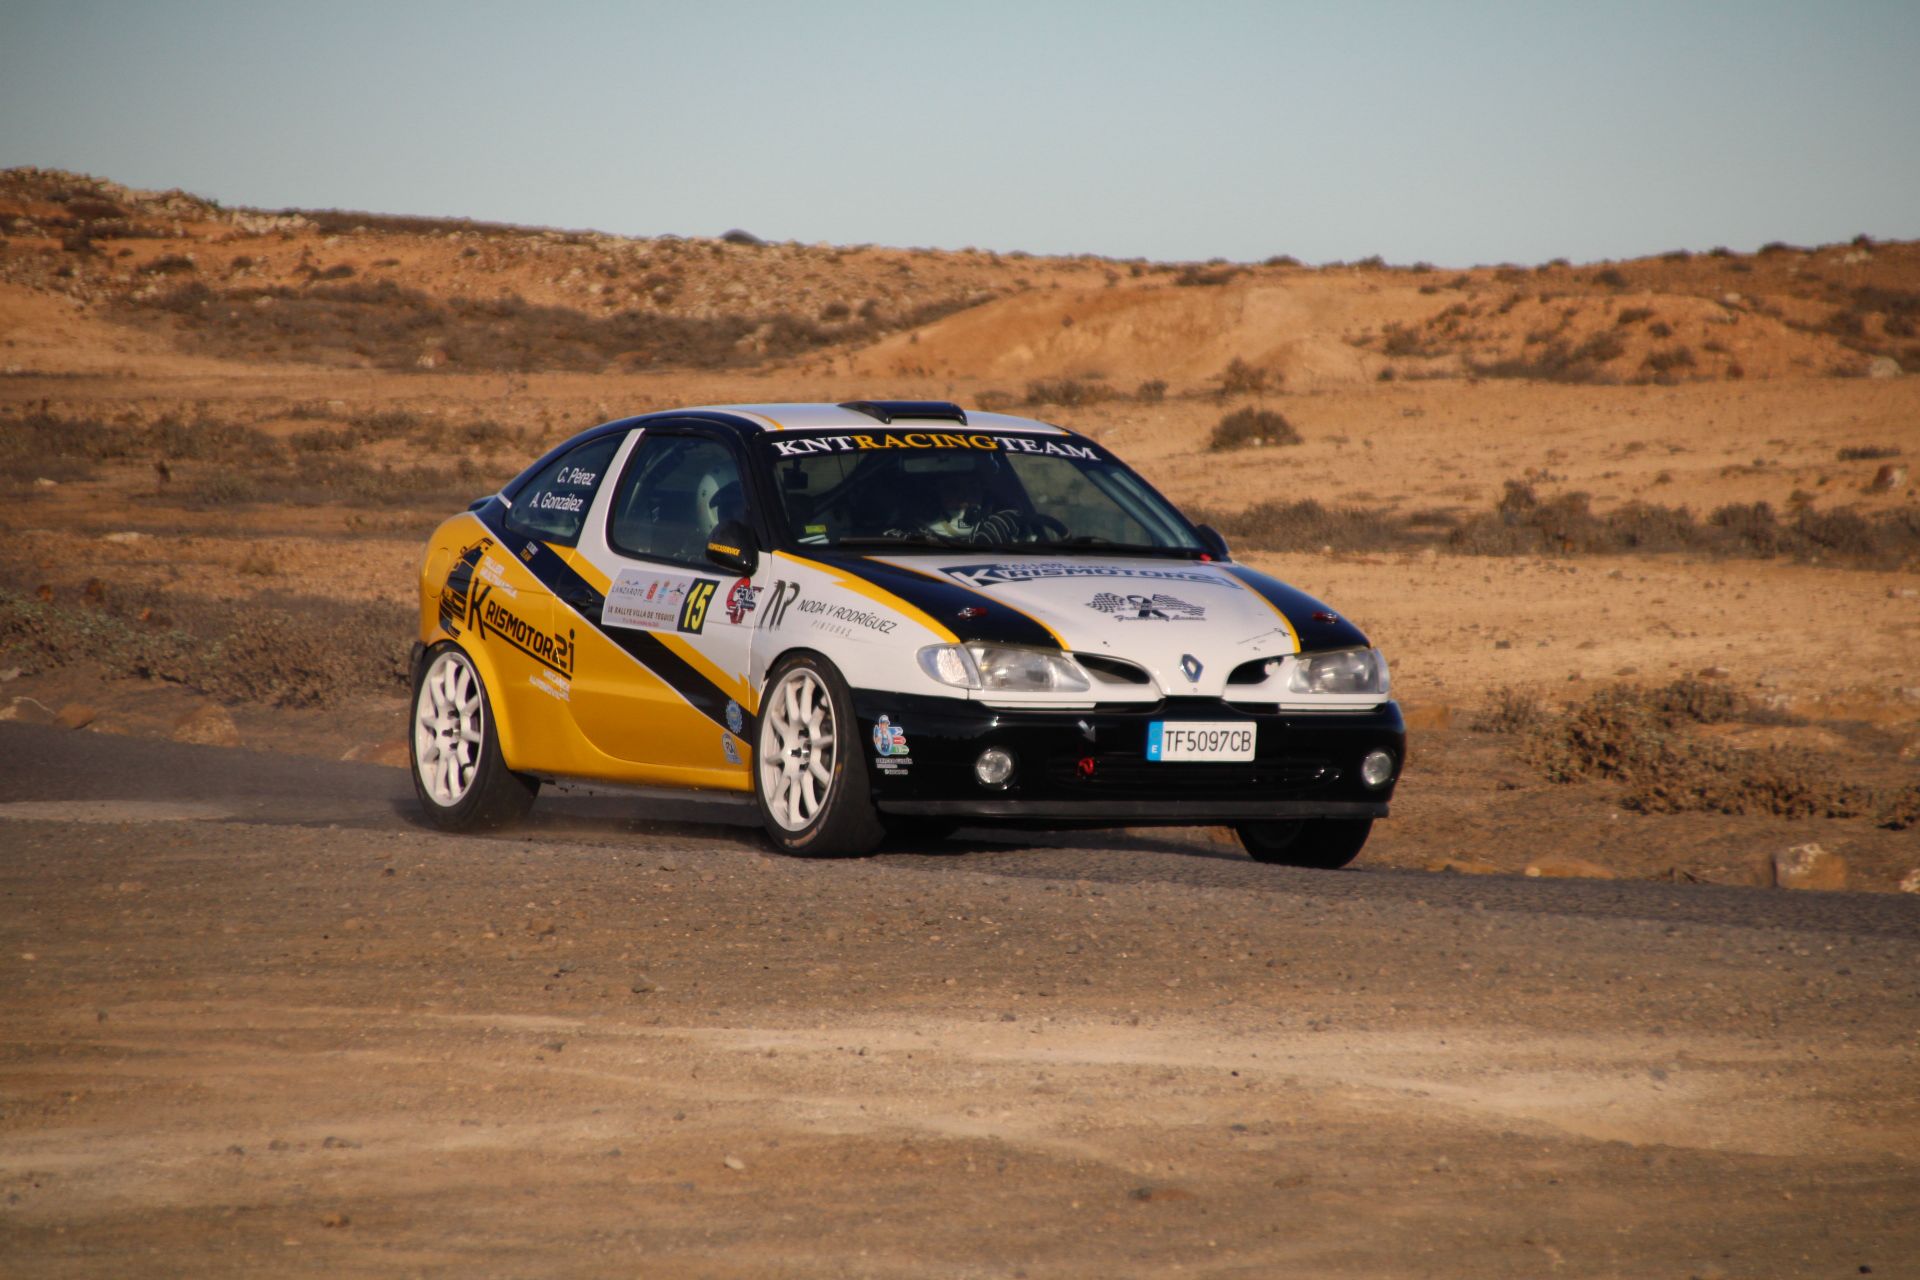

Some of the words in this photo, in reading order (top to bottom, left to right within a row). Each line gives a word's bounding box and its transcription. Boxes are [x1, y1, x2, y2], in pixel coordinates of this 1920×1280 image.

[567, 467, 596, 486] Pérez
[541, 491, 583, 512] González
[683, 582, 715, 631] 15
[798, 599, 824, 614] NODA
[826, 604, 836, 616] Y
[834, 607, 898, 634] RODRÍGUEZ
[1152, 745, 1158, 753] E
[1165, 730, 1252, 752] TF5097CB
